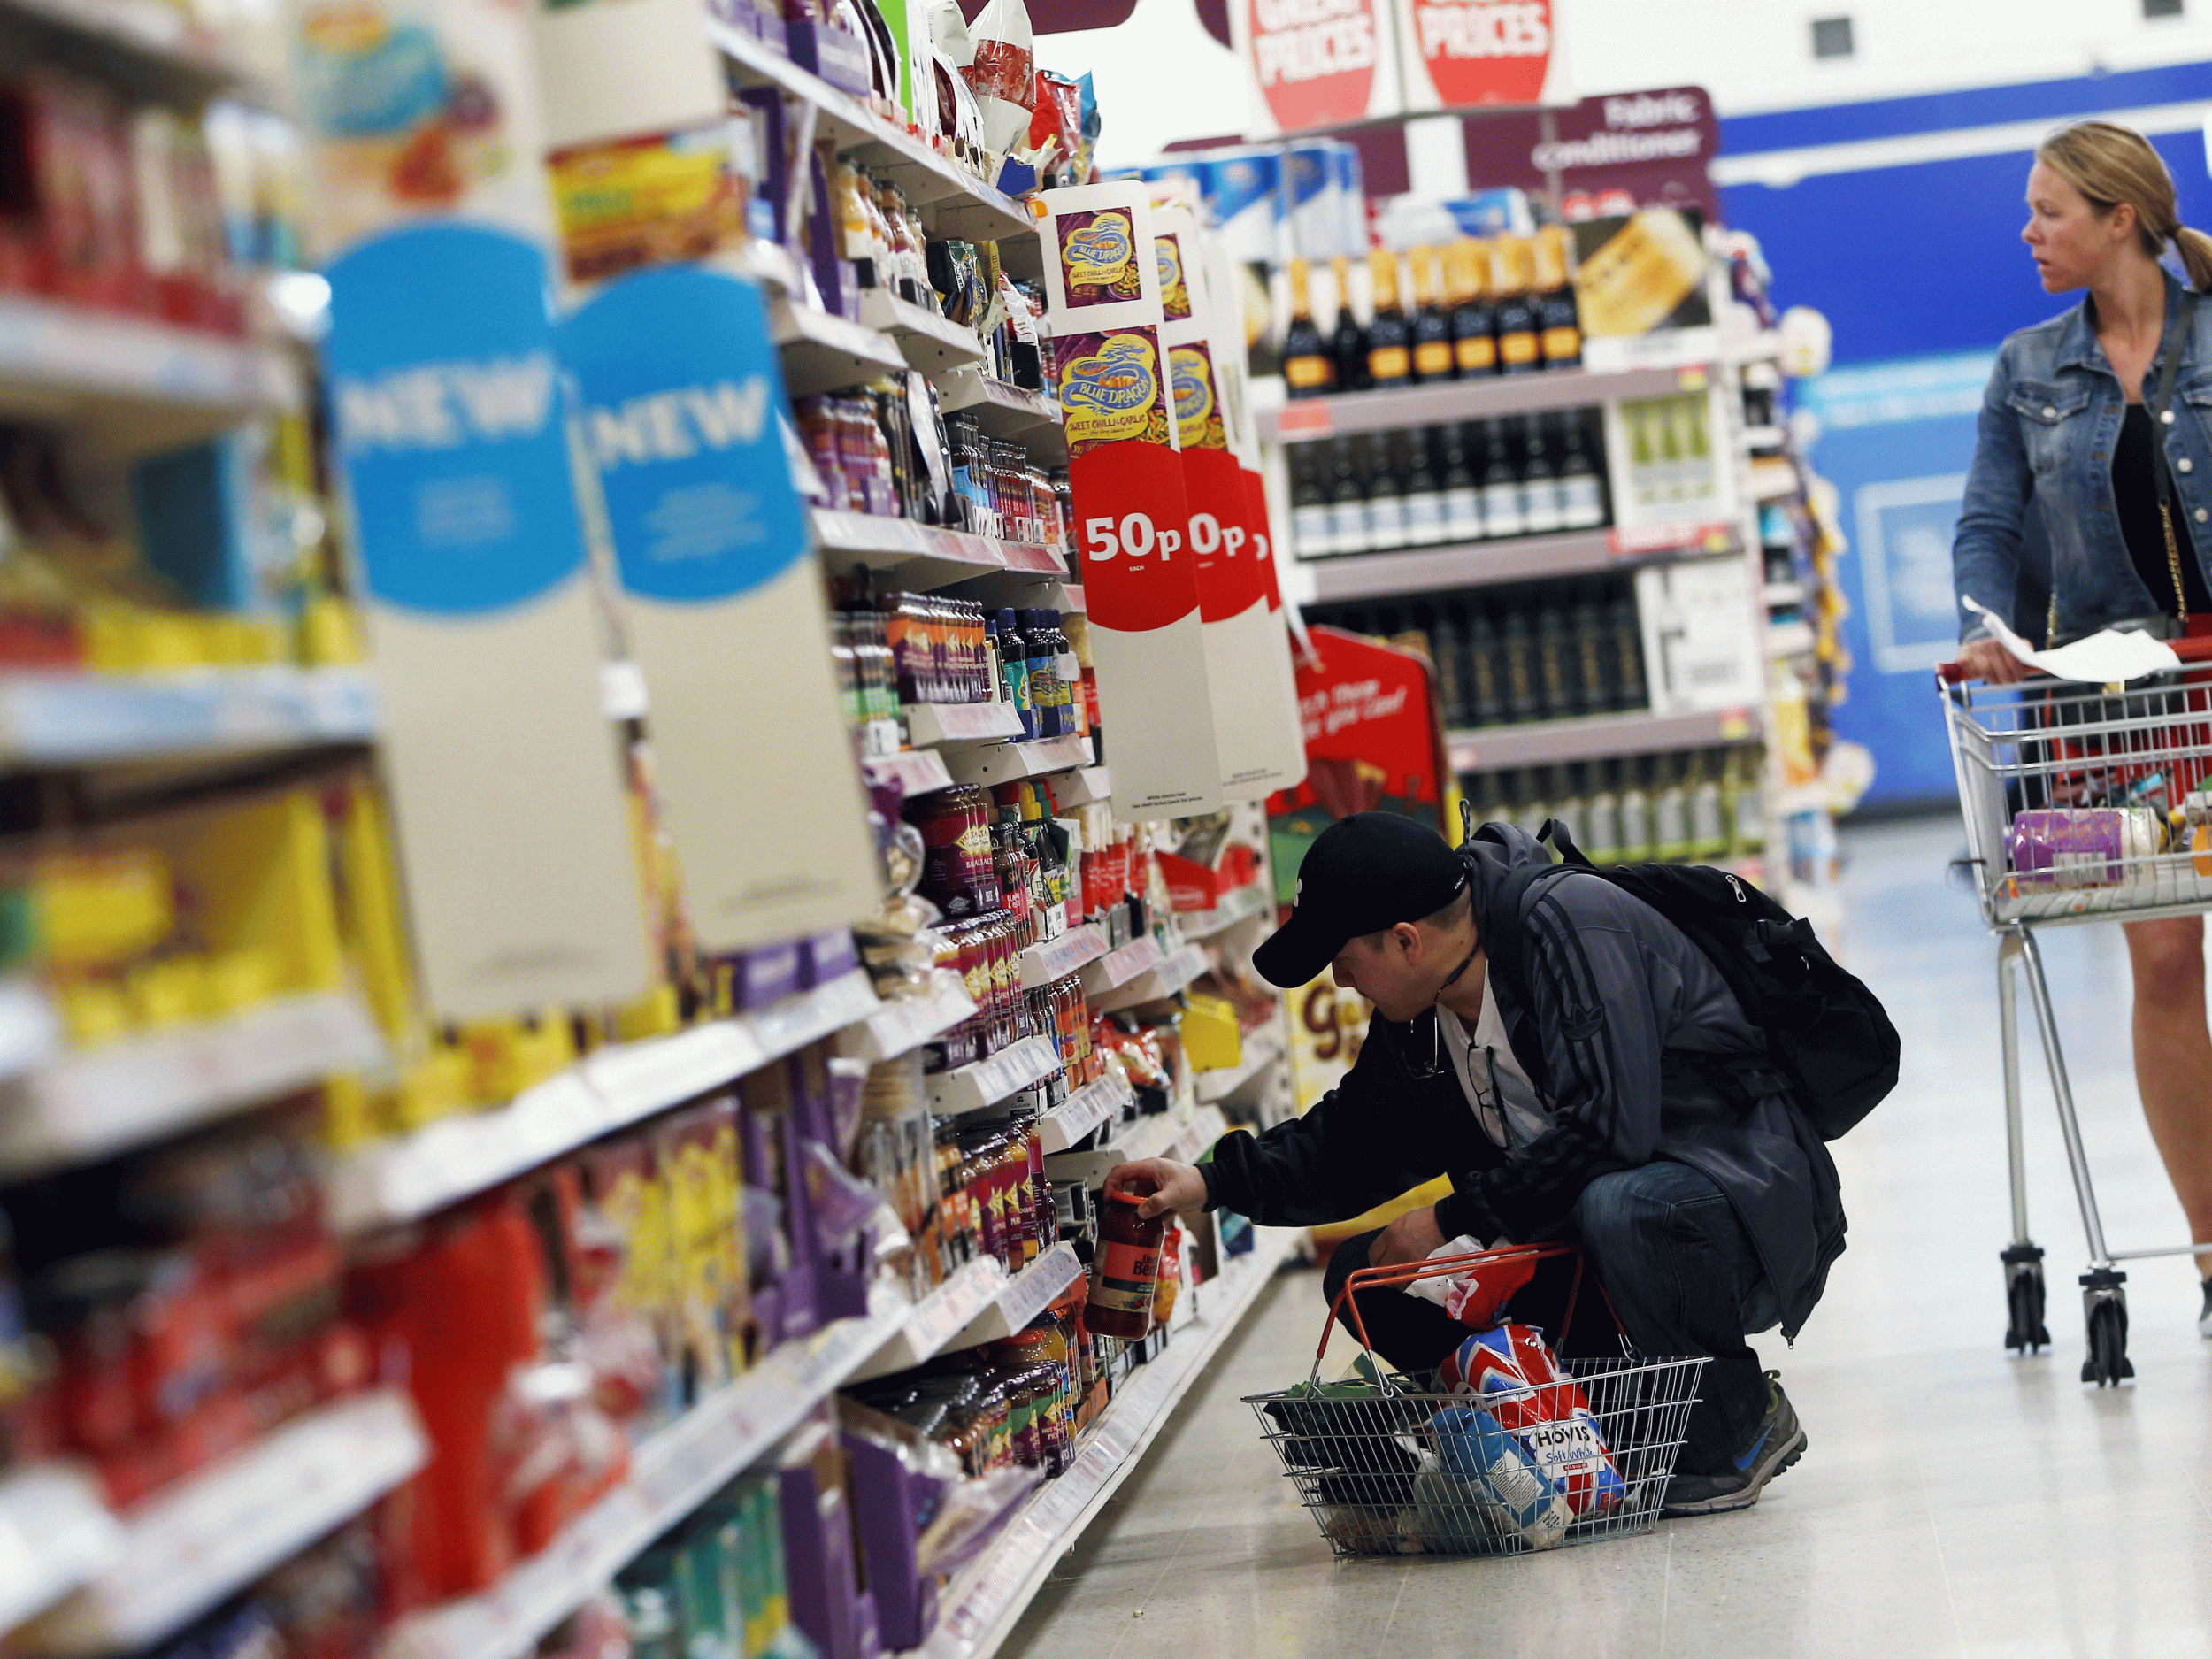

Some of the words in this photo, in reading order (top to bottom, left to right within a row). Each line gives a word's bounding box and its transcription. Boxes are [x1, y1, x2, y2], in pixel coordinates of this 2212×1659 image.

[1417, 4, 1550, 58] PRICES
[1604, 92, 1700, 130] Fabric
[340, 352, 557, 453] NEW
[1079, 383, 1105, 400] BLUE
[1108, 376, 1149, 404] DRAGON
[589, 375, 771, 470] NEW
[1069, 420, 1090, 432] SWEET
[1086, 512, 1182, 561] 50p
[1188, 512, 1246, 557] 0p
[1535, 1425, 1590, 1448] HOVIS
[1546, 1450, 1566, 1463] Soft
[1569, 1447, 1594, 1460] White
